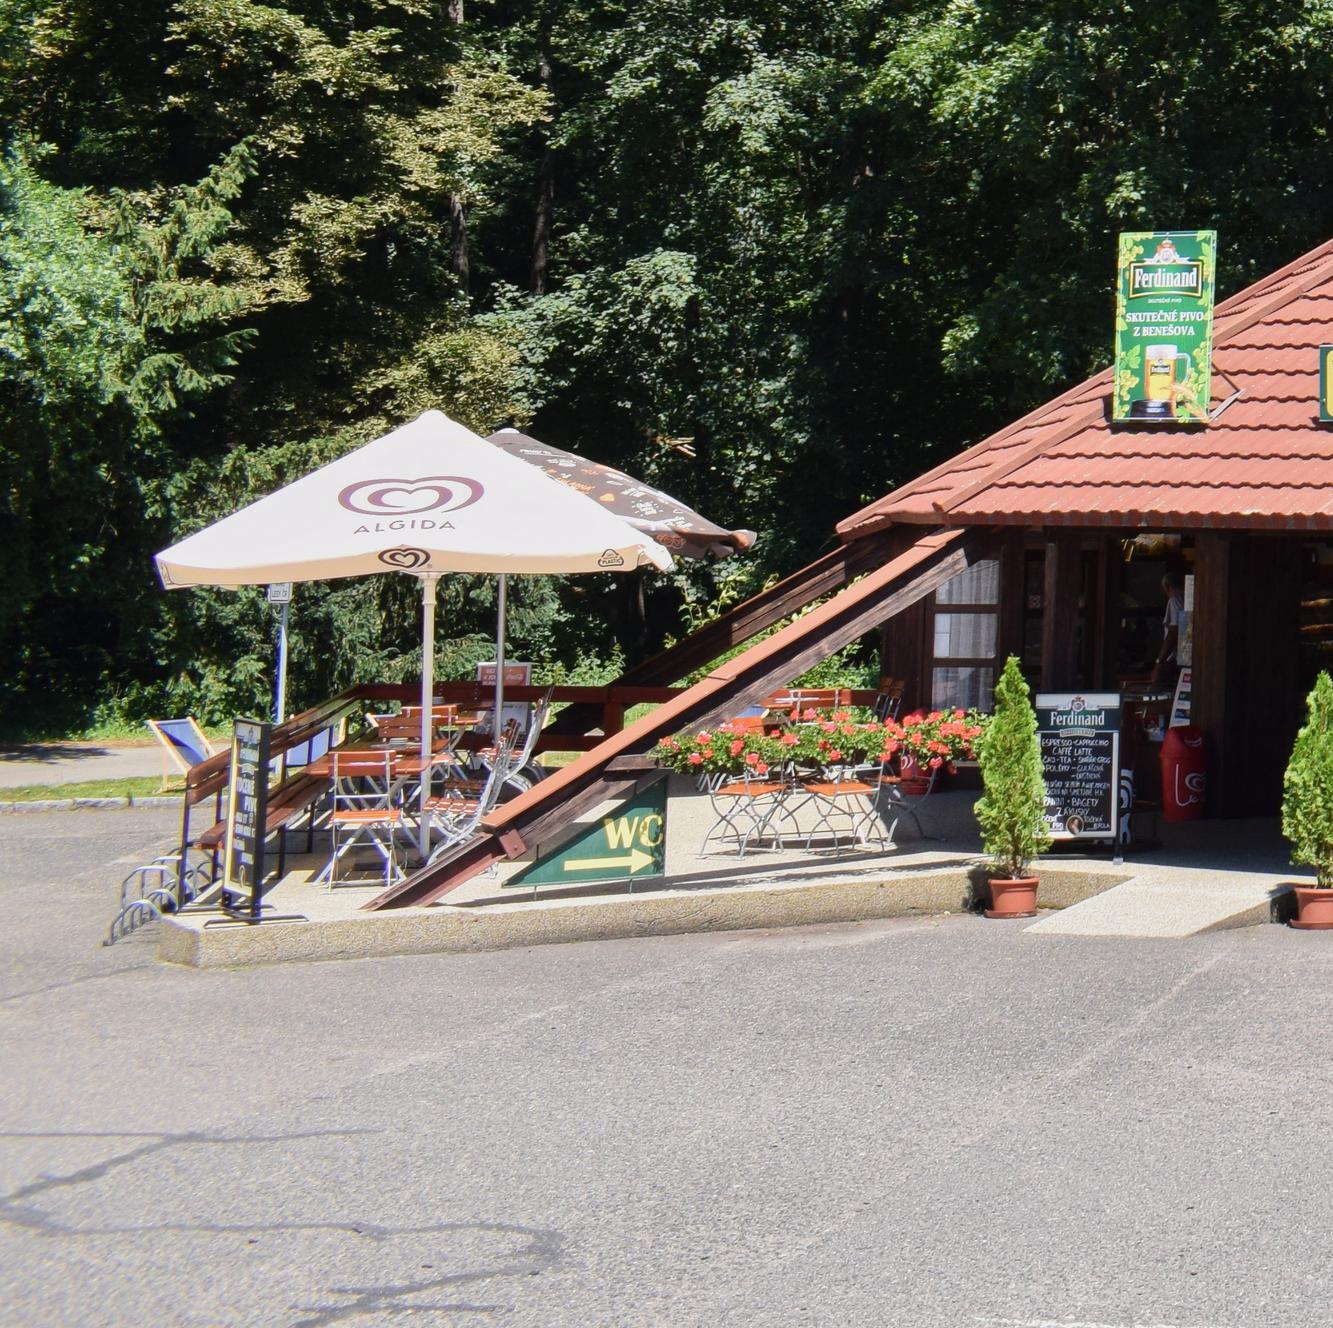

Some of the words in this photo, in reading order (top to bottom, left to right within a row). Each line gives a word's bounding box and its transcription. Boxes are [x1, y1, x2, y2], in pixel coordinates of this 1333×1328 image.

[1134, 267, 1197, 288] Ferdinand
[1126, 309, 1178, 322] SKUTEČNÉ
[1180, 311, 1204, 322] PIVO
[1133, 326, 1141, 337] Z
[1142, 324, 1196, 337] BENEŠOVA
[353, 519, 456, 535] ALGIDA
[1050, 710, 1105, 726] Ferdinand
[1074, 747, 1093, 756] LATTE
[604, 814, 664, 849] WC
